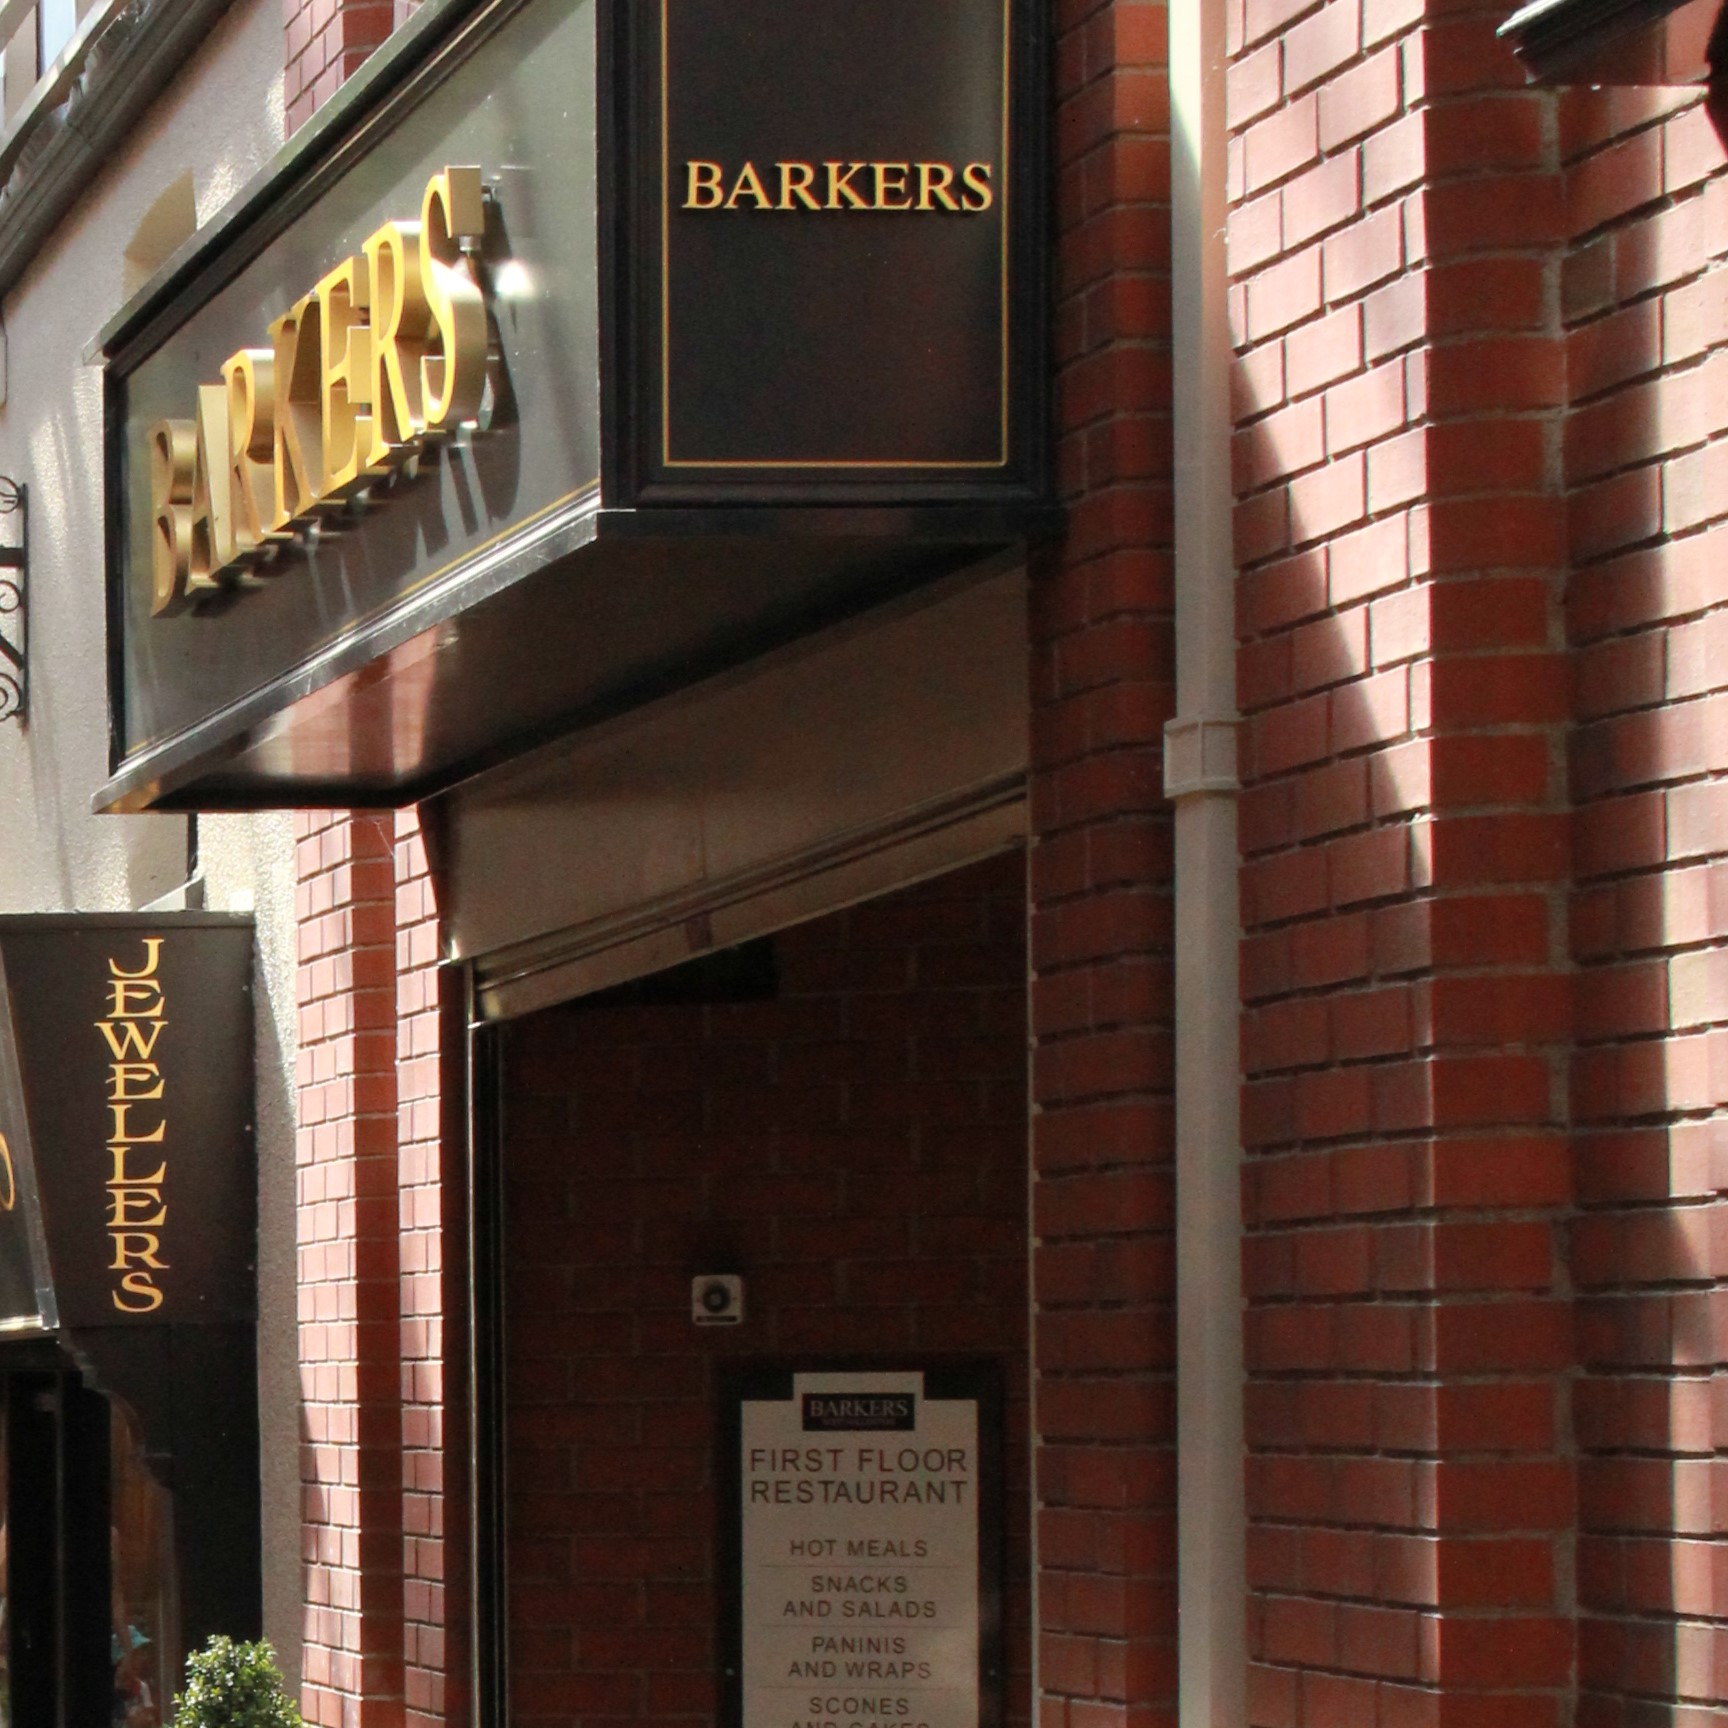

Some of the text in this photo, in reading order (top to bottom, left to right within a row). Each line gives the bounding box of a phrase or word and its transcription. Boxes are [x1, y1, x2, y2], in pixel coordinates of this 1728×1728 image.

[683, 160, 992, 212] BARKERS
[150, 165, 488, 616] BARKERS
[95, 938, 170, 1313] JEWELLERS
[810, 1399, 908, 1417] BARKERS
[750, 1449, 968, 1473] FIRST FLOOR
[751, 1480, 968, 1504] RESTAURANT
[790, 1539, 928, 1557] HOT MEALS
[811, 1575, 908, 1593] SNACKS
[783, 1601, 937, 1618] AND SALADS
[812, 1636, 905, 1654] PANINIS
[788, 1661, 932, 1680] AND WRAPS
[809, 1697, 909, 1715] SCONES
